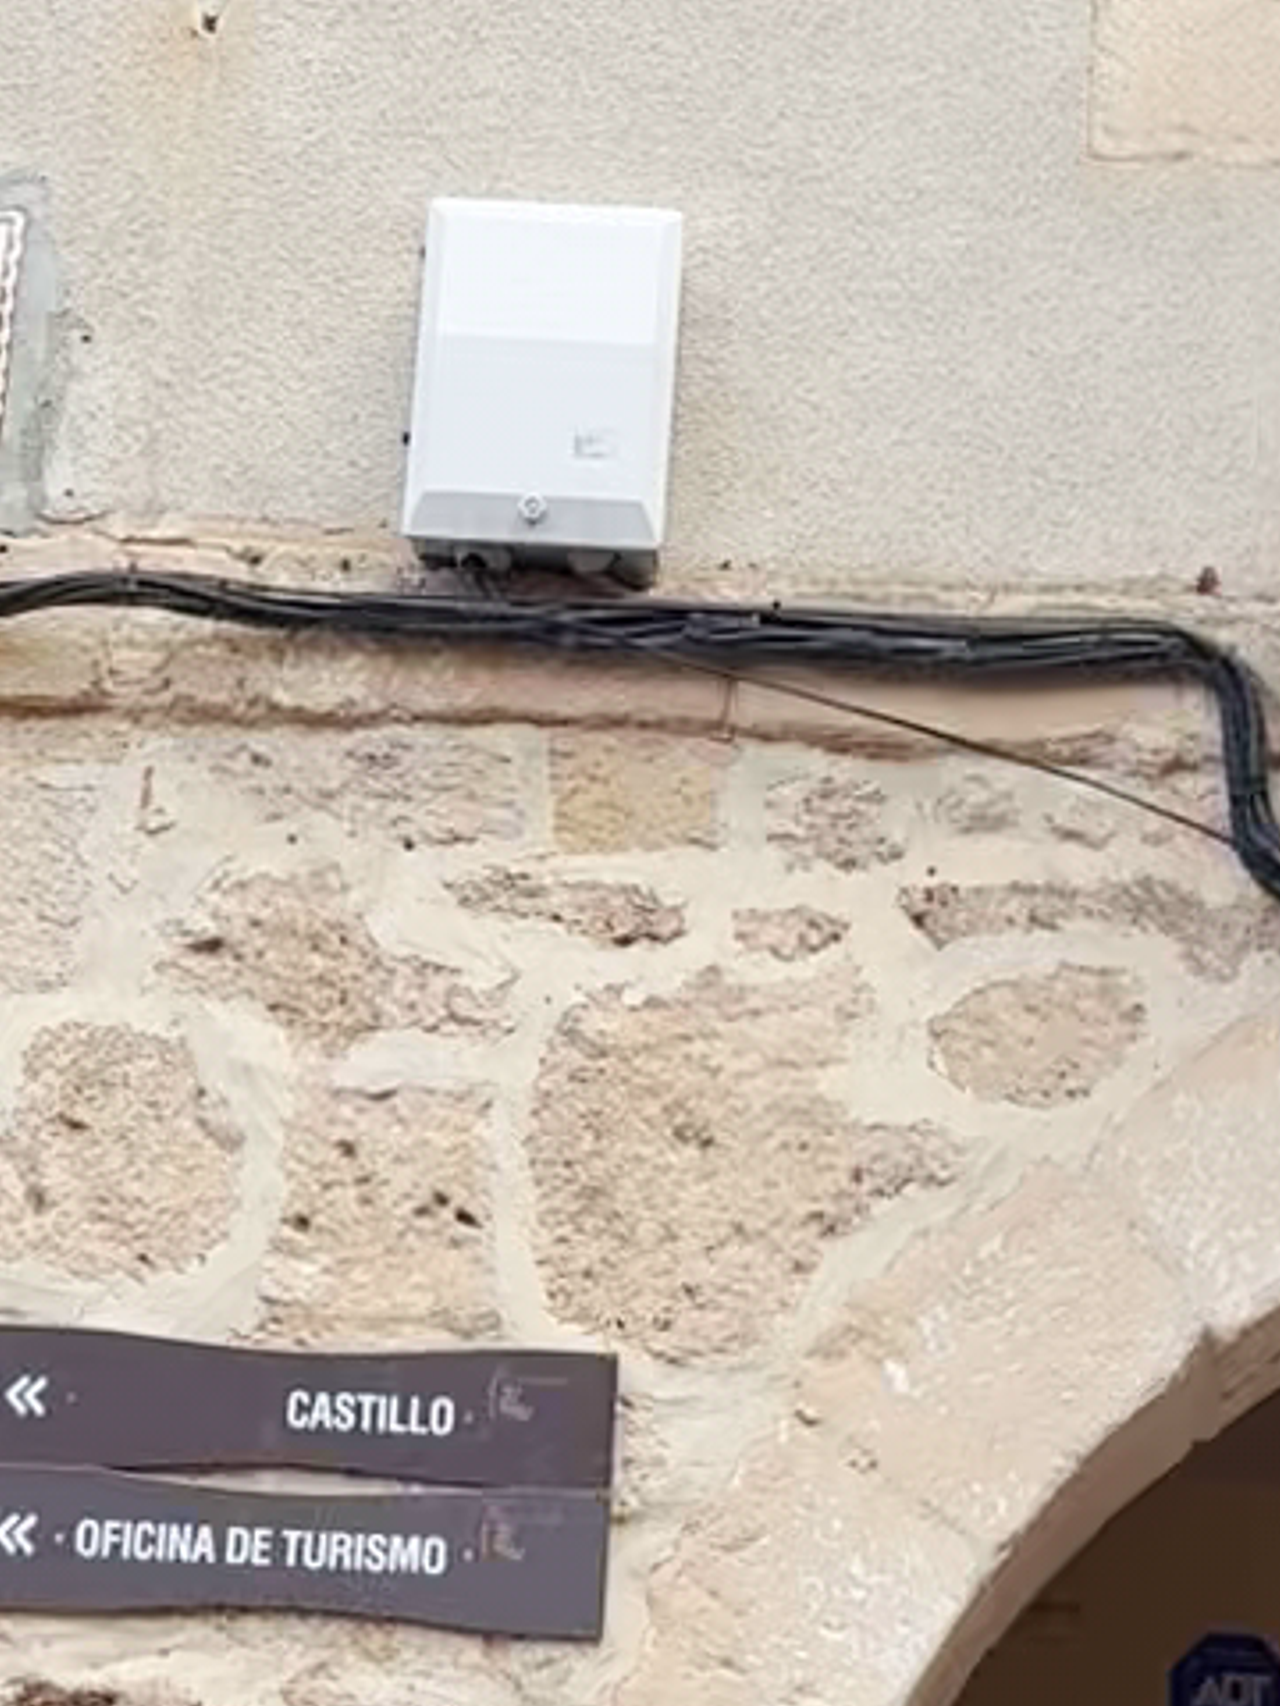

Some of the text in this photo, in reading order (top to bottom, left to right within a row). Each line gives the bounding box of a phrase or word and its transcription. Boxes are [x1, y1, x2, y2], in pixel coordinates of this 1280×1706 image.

[286, 1389, 456, 1436] CASTILLO
[74, 1519, 449, 1575] OFICINA DE TURISMO
